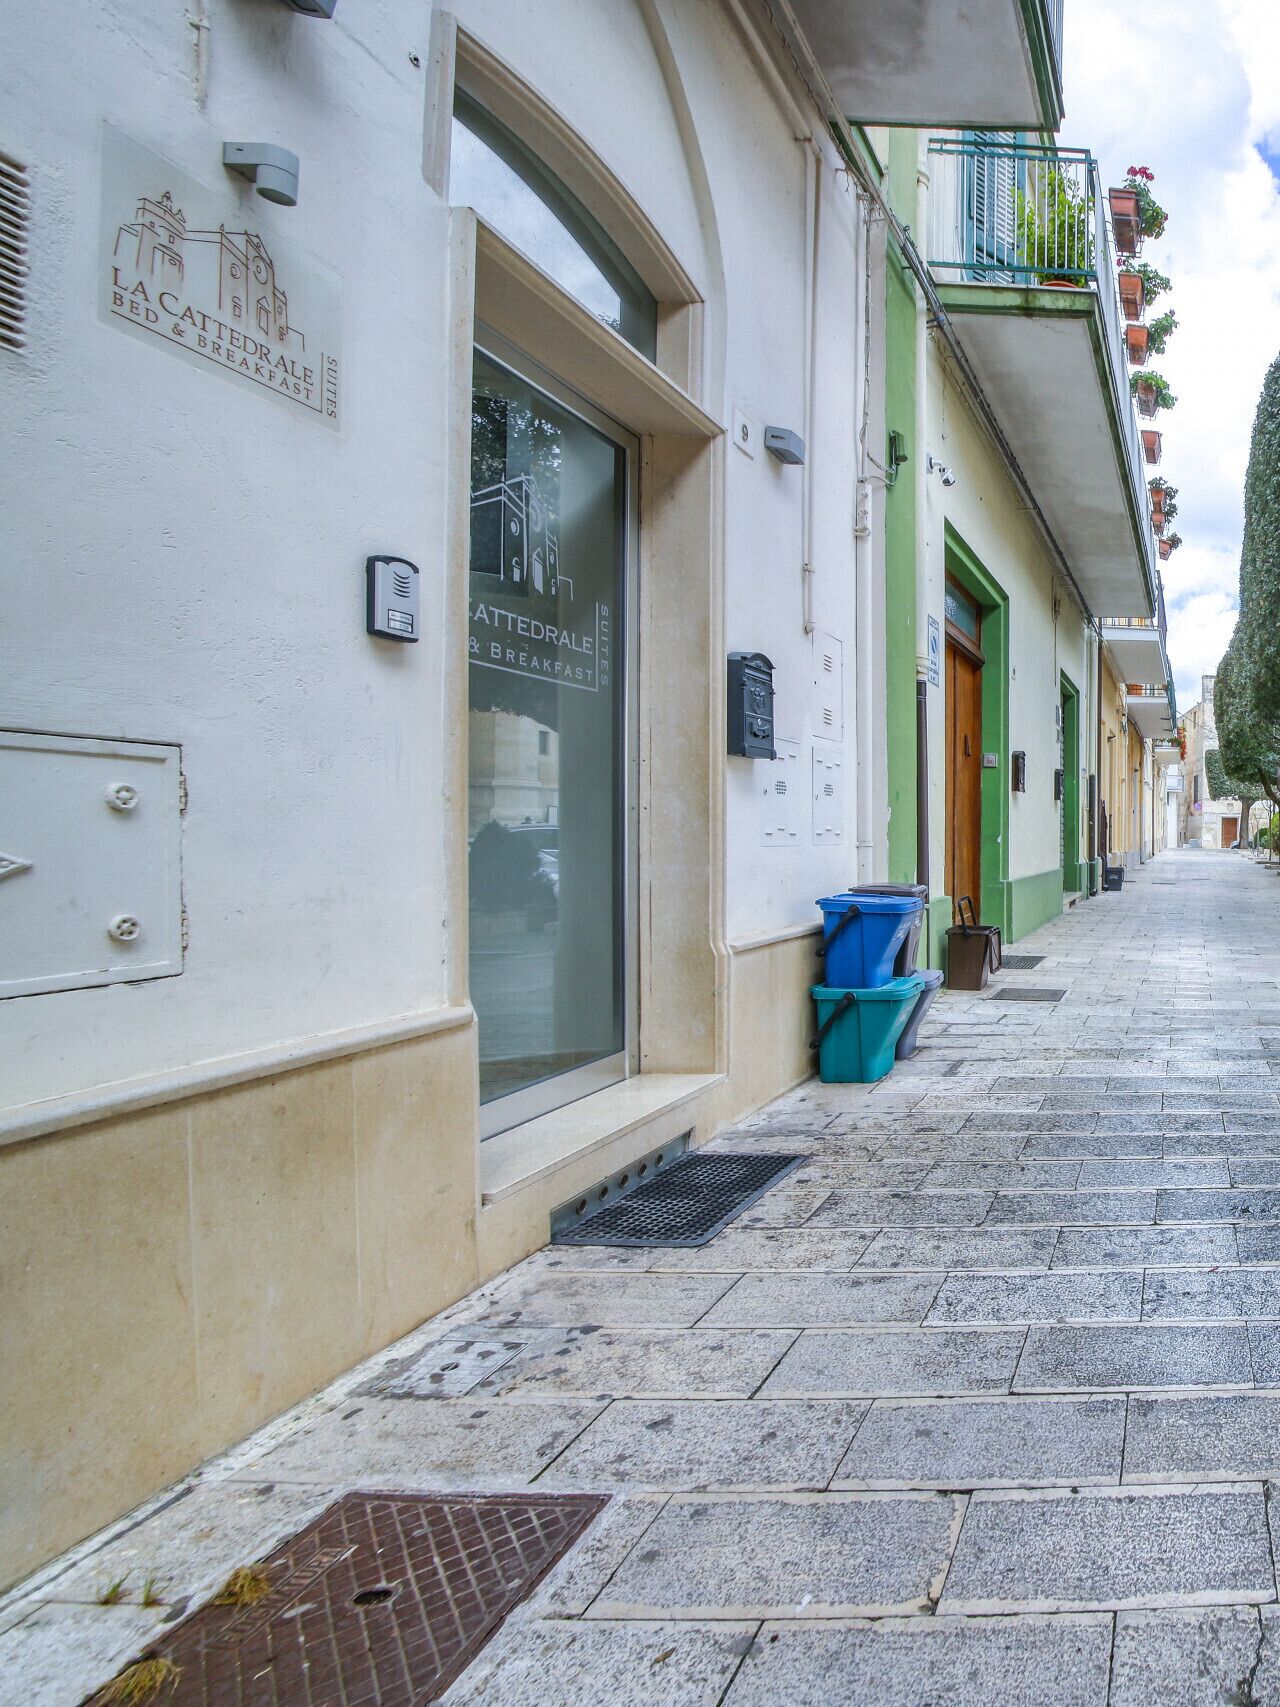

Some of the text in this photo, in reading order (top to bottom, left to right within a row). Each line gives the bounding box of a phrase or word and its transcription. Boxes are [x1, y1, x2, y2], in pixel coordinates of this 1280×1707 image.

[112, 265, 314, 387] LA CATTEDRALE
[113, 291, 312, 401] BED & BREAKFAST
[326, 356, 338, 419] SUITES
[469, 598, 594, 655] ATTEDRALE
[469, 636, 594, 683] & BREAKFAST
[600, 604, 609, 686] SUITES
